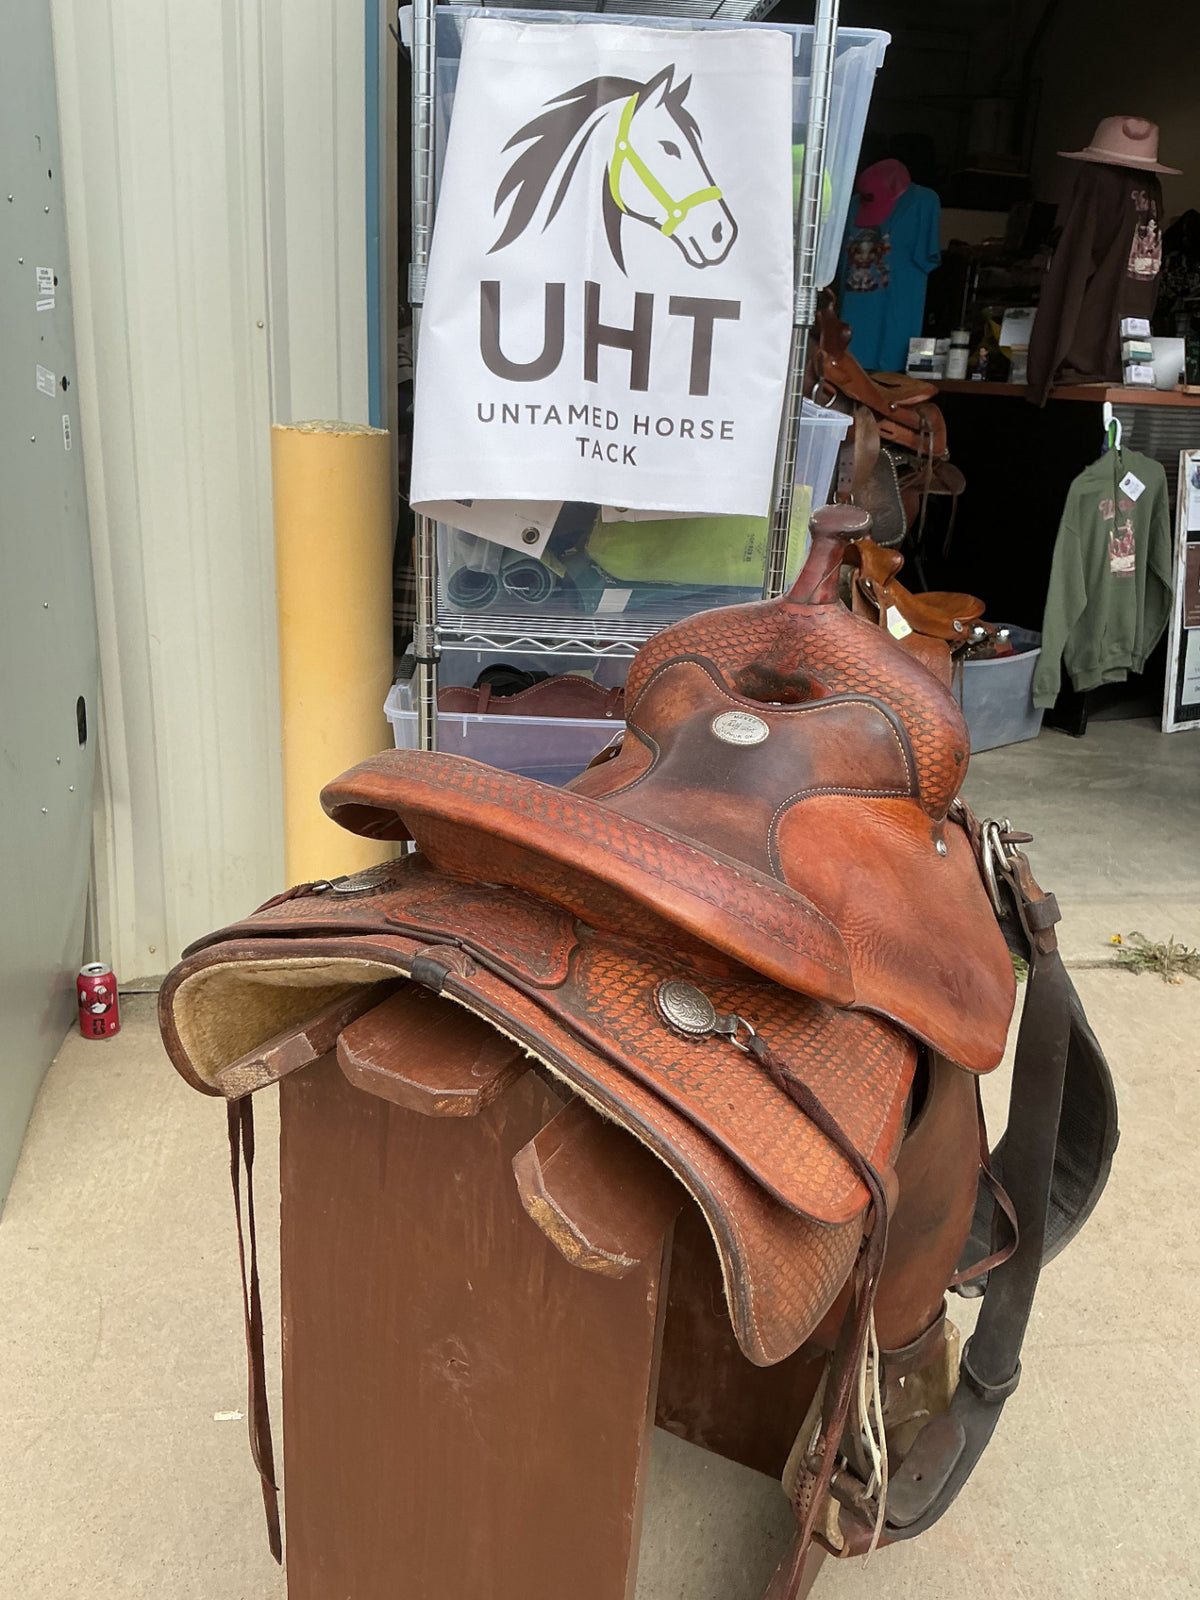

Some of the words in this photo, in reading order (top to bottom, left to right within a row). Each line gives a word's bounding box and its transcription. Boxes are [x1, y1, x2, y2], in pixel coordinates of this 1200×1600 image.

[480, 280, 741, 396] UHT
[477, 402, 619, 431] UNTAMED
[633, 414, 735, 441] HORSE
[575, 437, 637, 467] TACK
